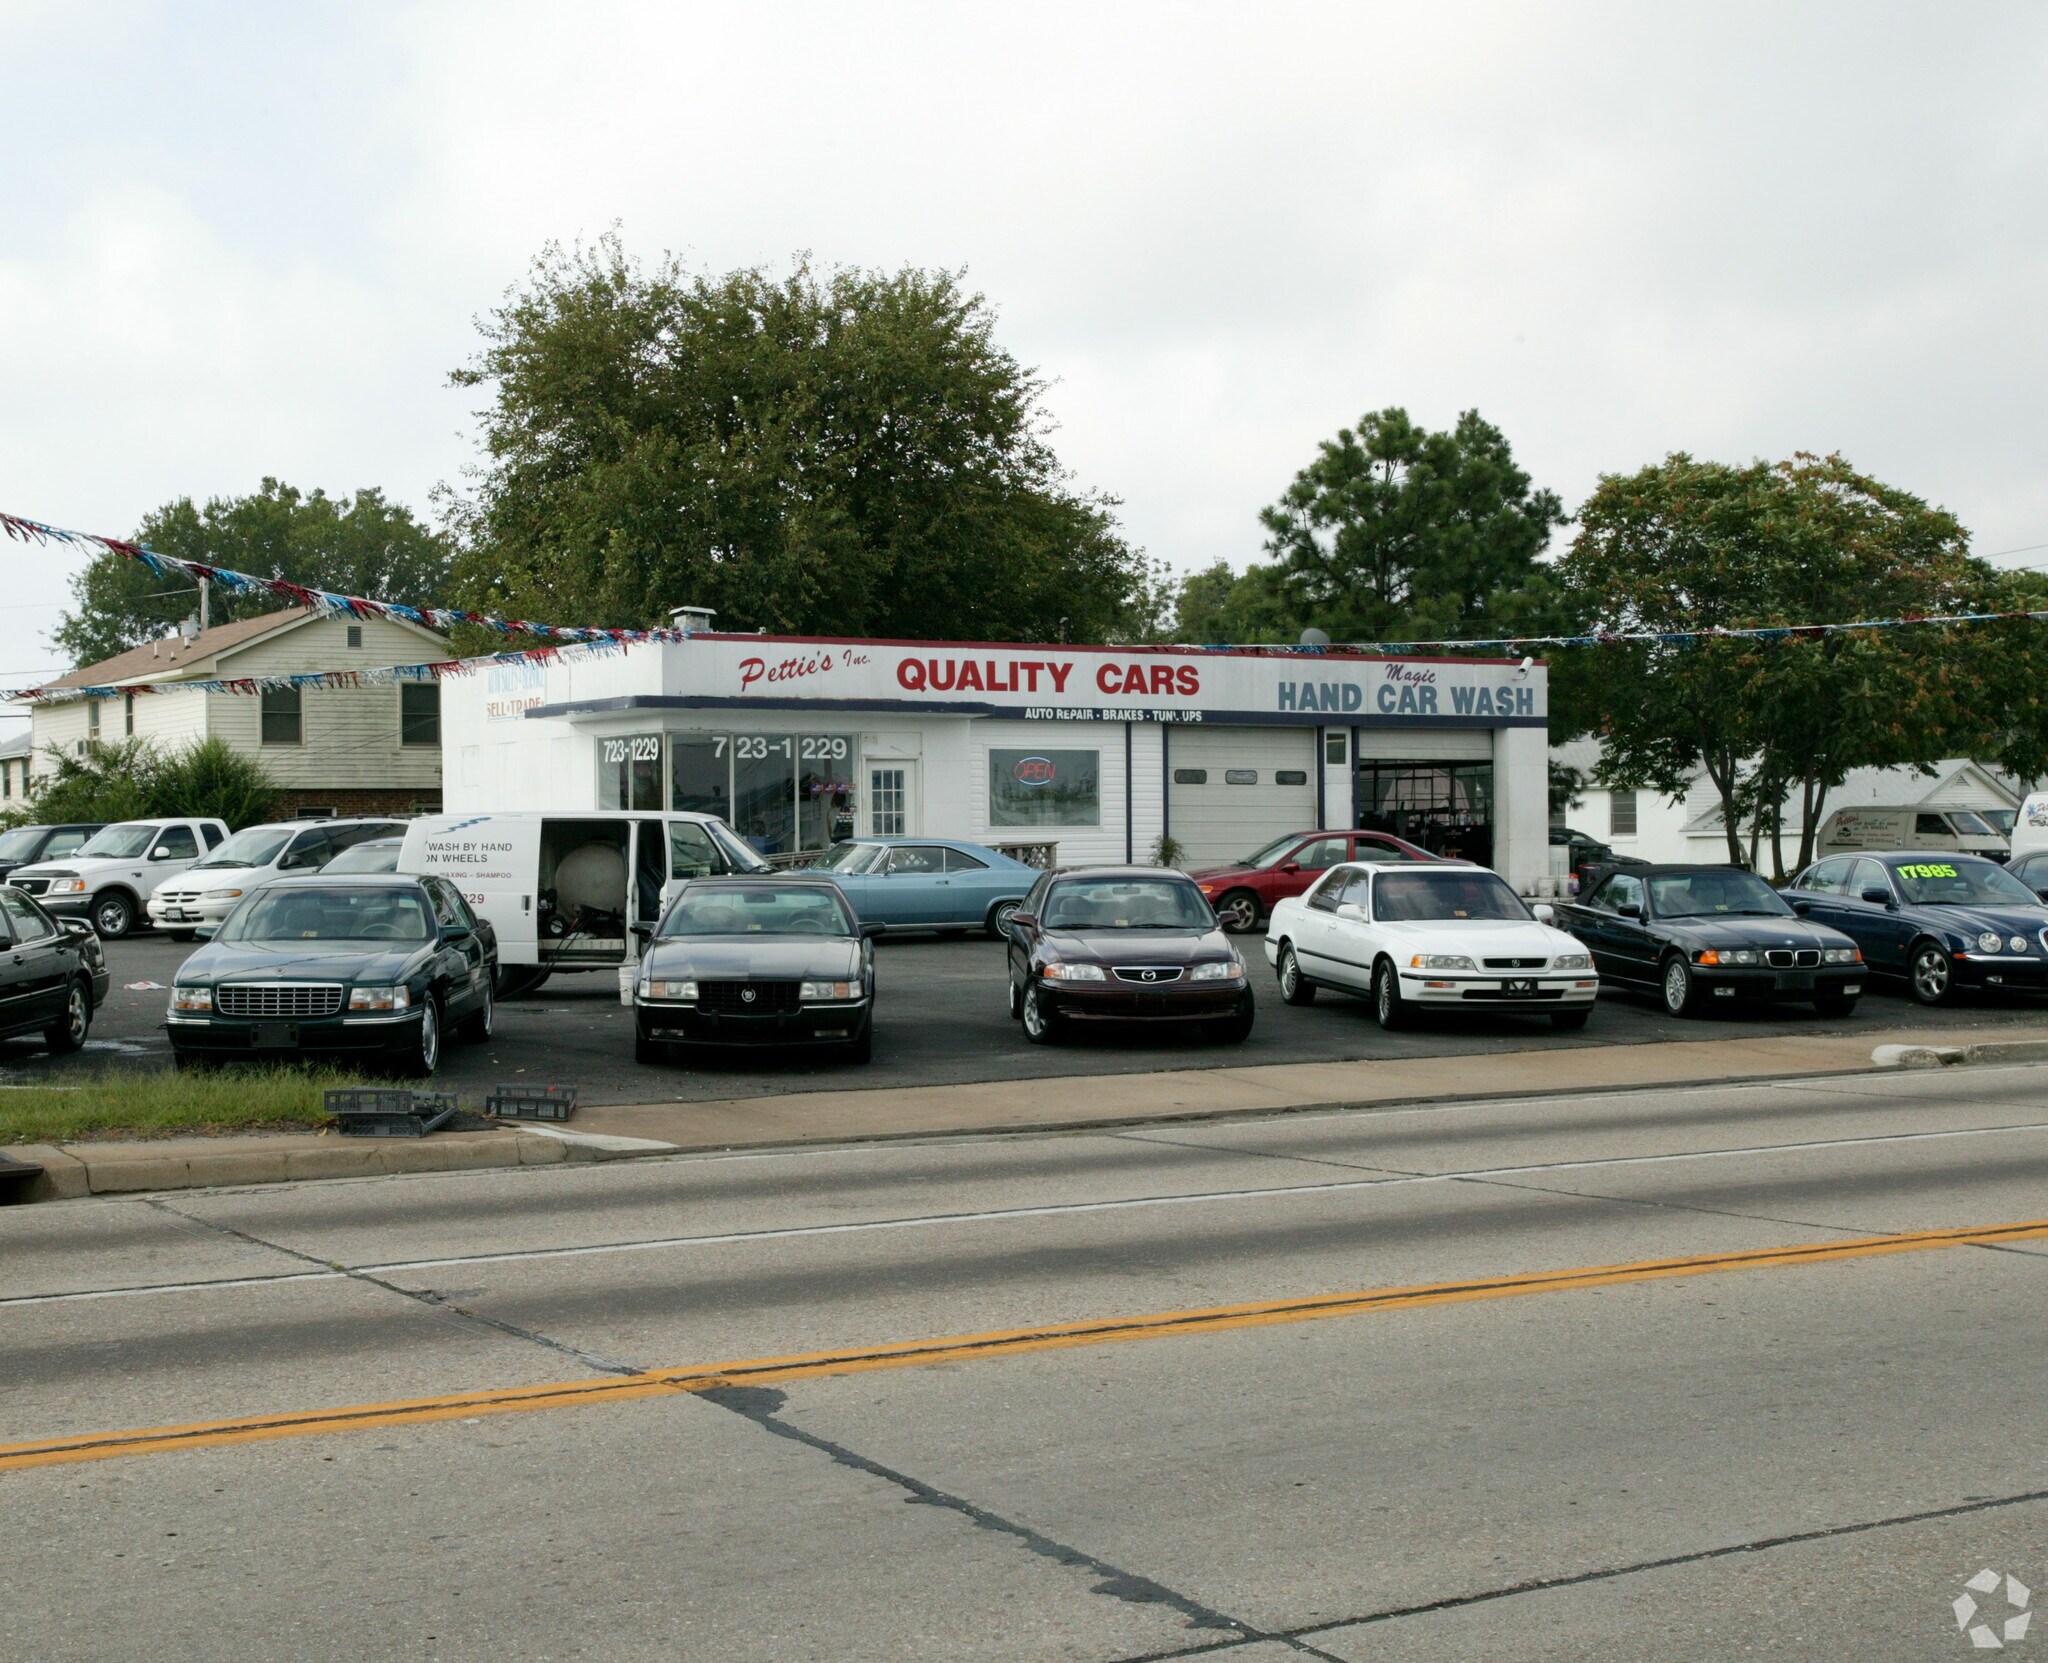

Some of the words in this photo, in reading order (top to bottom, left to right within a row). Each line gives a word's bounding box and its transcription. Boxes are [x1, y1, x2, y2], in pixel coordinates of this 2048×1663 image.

[738, 650, 834, 693] Pettie's
[842, 649, 871, 667] Inc.
[896, 657, 1074, 693] QUALITY
[1096, 663, 1200, 696] CARS
[1385, 663, 1437, 688] Magic
[1278, 681, 1363, 712] HAND
[1376, 683, 1438, 714] CAR
[1450, 686, 1534, 716] WASH
[1024, 707, 1054, 720] AUTO
[1056, 708, 1094, 720] REPAIR
[1102, 709, 1144, 721] BRAKES
[603, 737, 659, 763] 723-1229
[1014, 762, 1056, 780] OPEN
[428, 842, 460, 852] WASH
[463, 842, 477, 852] BY
[481, 842, 513, 852] HAND
[442, 854, 488, 863] WHEELS
[1896, 863, 1958, 880] 17985
